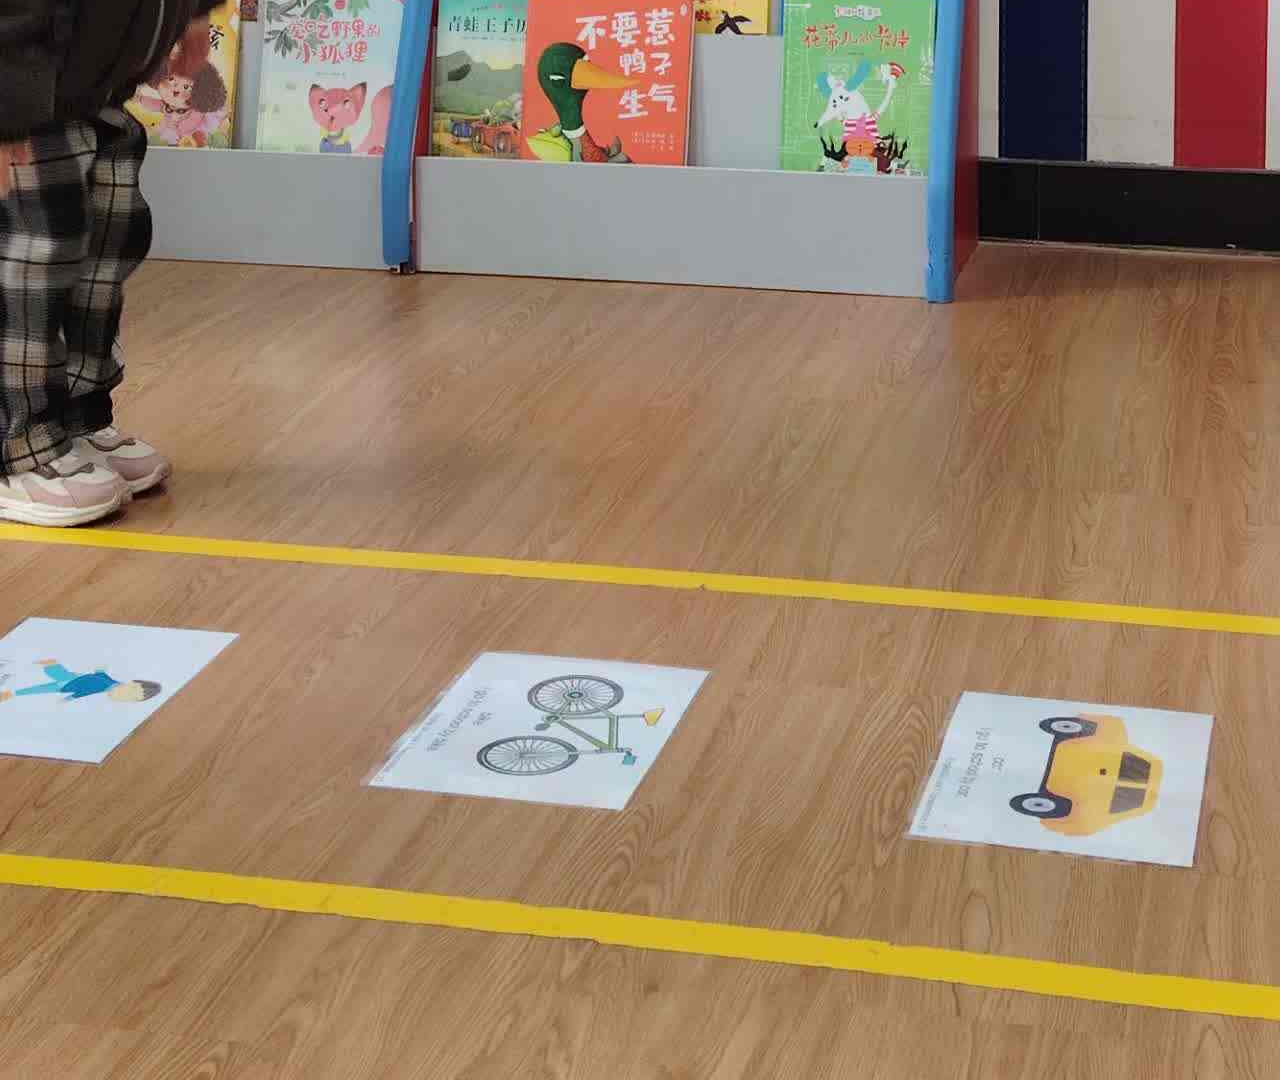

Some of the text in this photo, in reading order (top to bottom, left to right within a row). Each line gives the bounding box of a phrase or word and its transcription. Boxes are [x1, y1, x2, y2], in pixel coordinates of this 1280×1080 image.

[575, 8, 676, 50] 不要惹
[295, 41, 368, 64] 小狐狸
[619, 48, 673, 77] 鸭子
[617, 83, 677, 120] 生气
